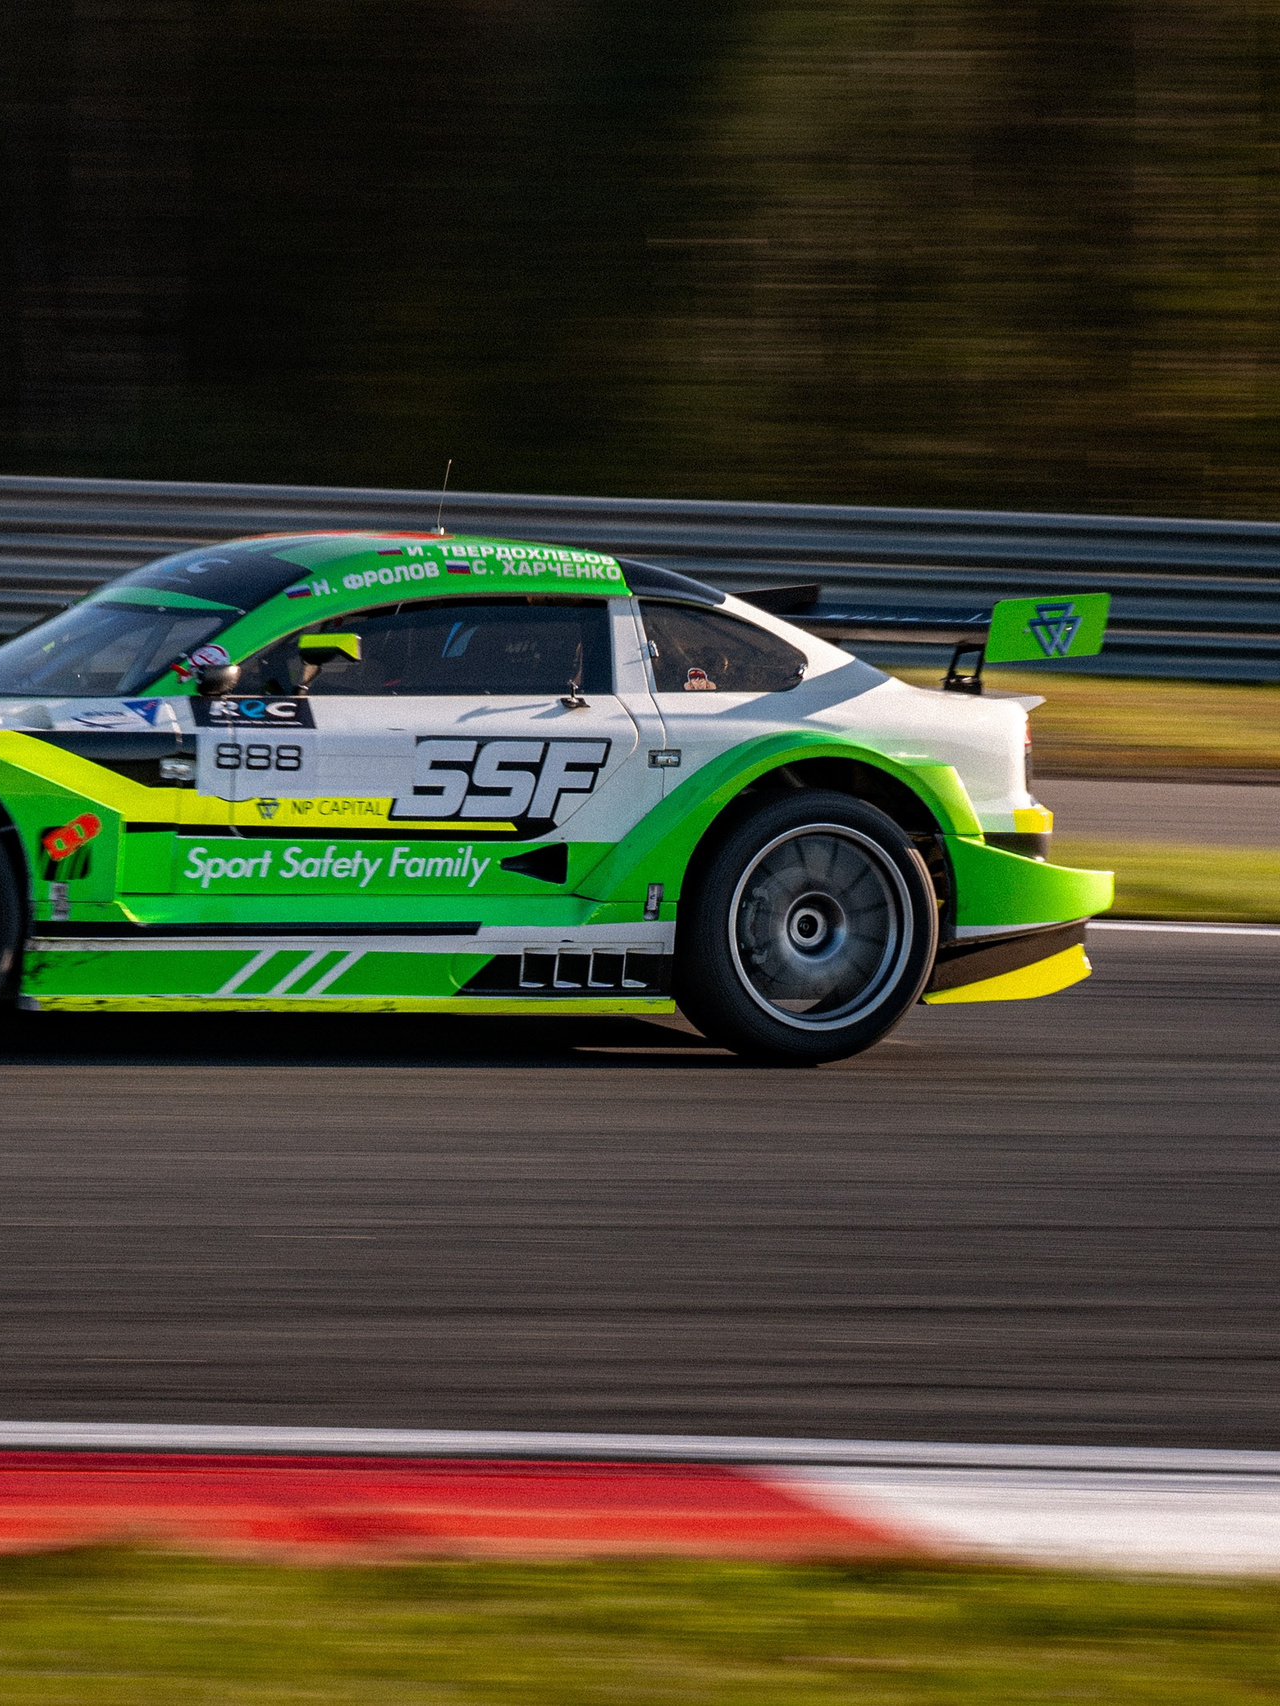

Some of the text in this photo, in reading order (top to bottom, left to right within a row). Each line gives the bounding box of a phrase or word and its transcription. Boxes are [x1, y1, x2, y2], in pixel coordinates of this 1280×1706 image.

[439, 546, 615, 566] ТВЕРДОХЛЕБОВ
[473, 560, 621, 580] С. ХАРЧЕНКО
[342, 560, 440, 590] ФРОЛОВ
[216, 743, 302, 771] 888
[391, 738, 611, 820] SSF
[291, 800, 384, 816] NP CAPITAL
[184, 846, 491, 888] Sport Safety Family
